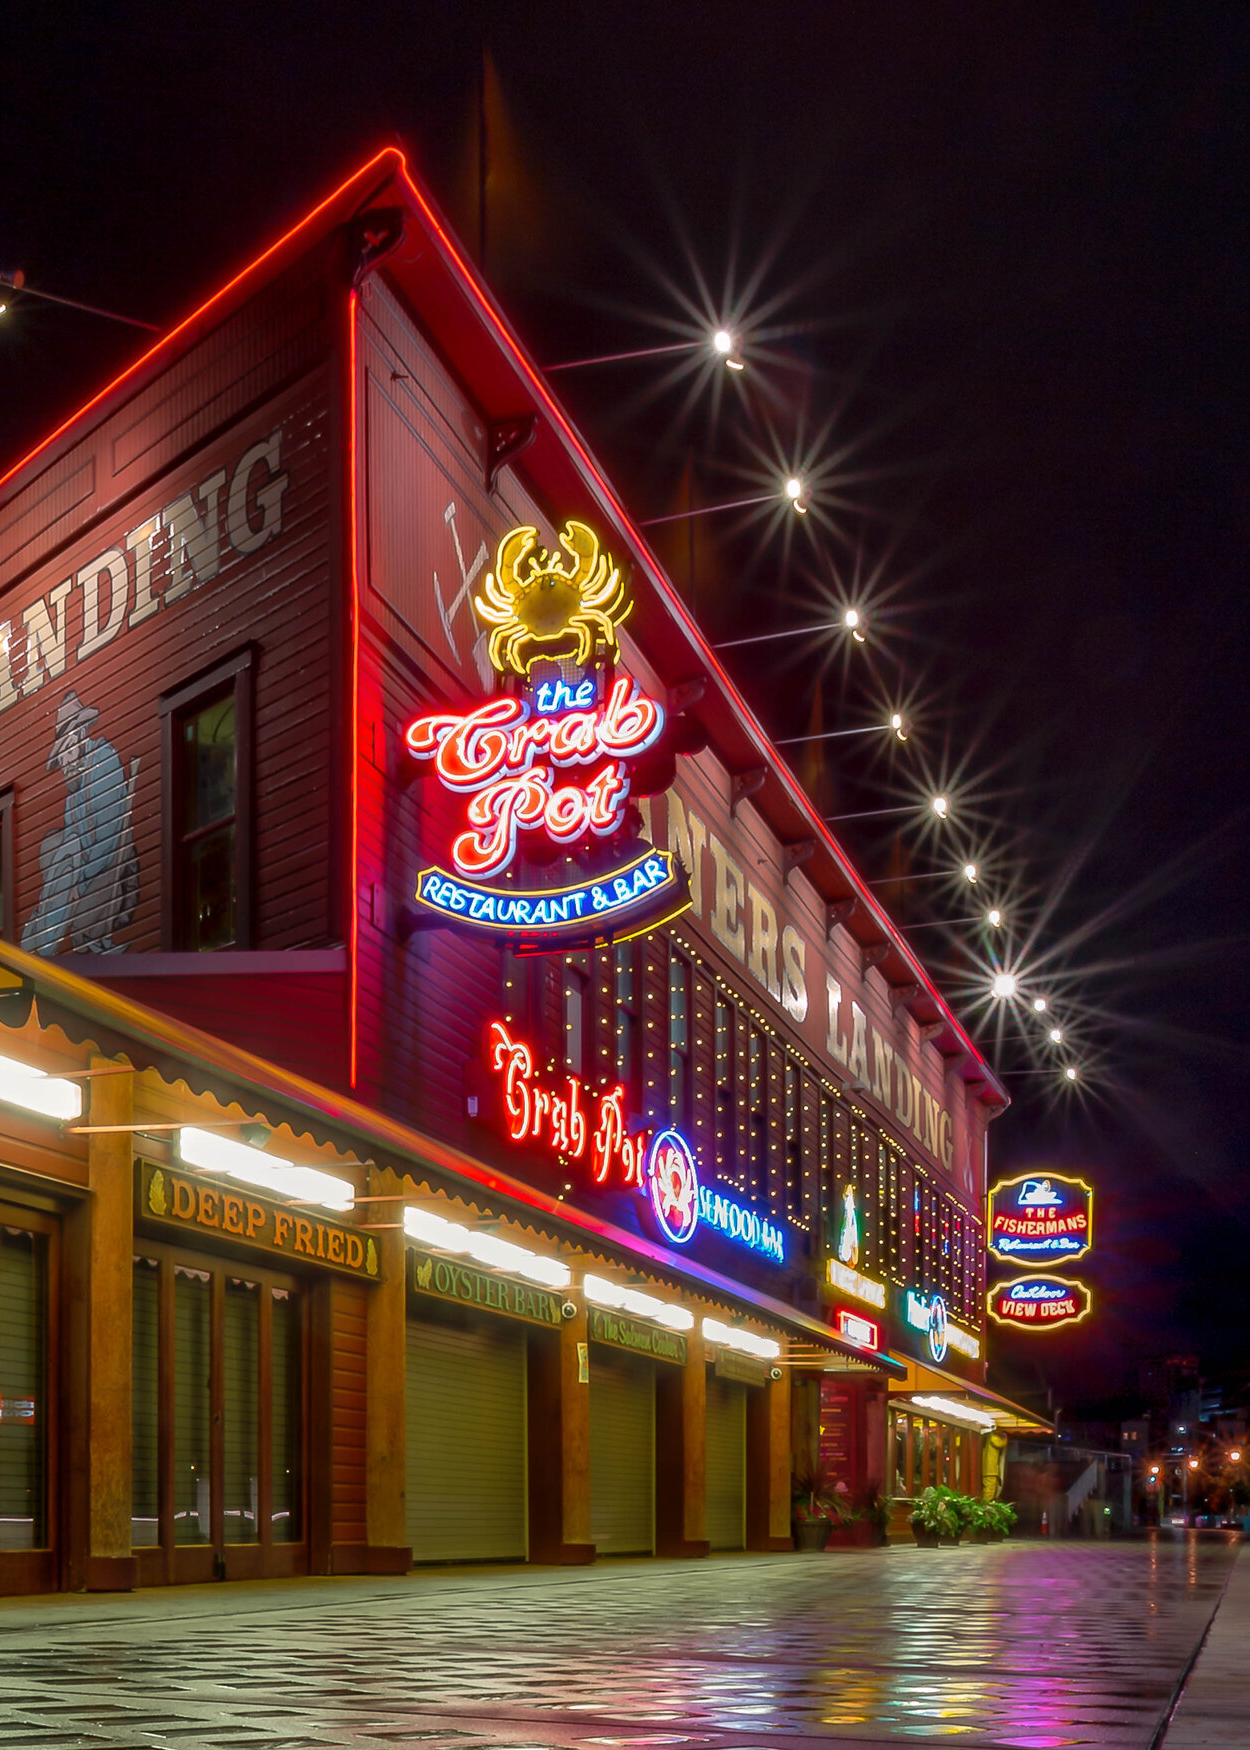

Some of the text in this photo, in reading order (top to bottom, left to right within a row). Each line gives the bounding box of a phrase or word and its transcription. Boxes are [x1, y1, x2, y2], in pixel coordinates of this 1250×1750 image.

[535, 678, 595, 713] the
[406, 675, 665, 793] Crab
[452, 761, 630, 880] Pot
[422, 858, 668, 925] RESTAURANT & BAR
[826, 971, 954, 1171] LANDING
[490, 1021, 645, 1188] Crab Pot
[171, 1177, 363, 1268] DEEP FRIED
[697, 1185, 761, 1248] SEAFOOD
[994, 1214, 1087, 1236] FISHERMANS
[1025, 1207, 1057, 1219] THE
[434, 1262, 550, 1322] OYSTER BAR
[1002, 1300, 1076, 1317] VIEW DECK
[602, 1314, 618, 1341] The
